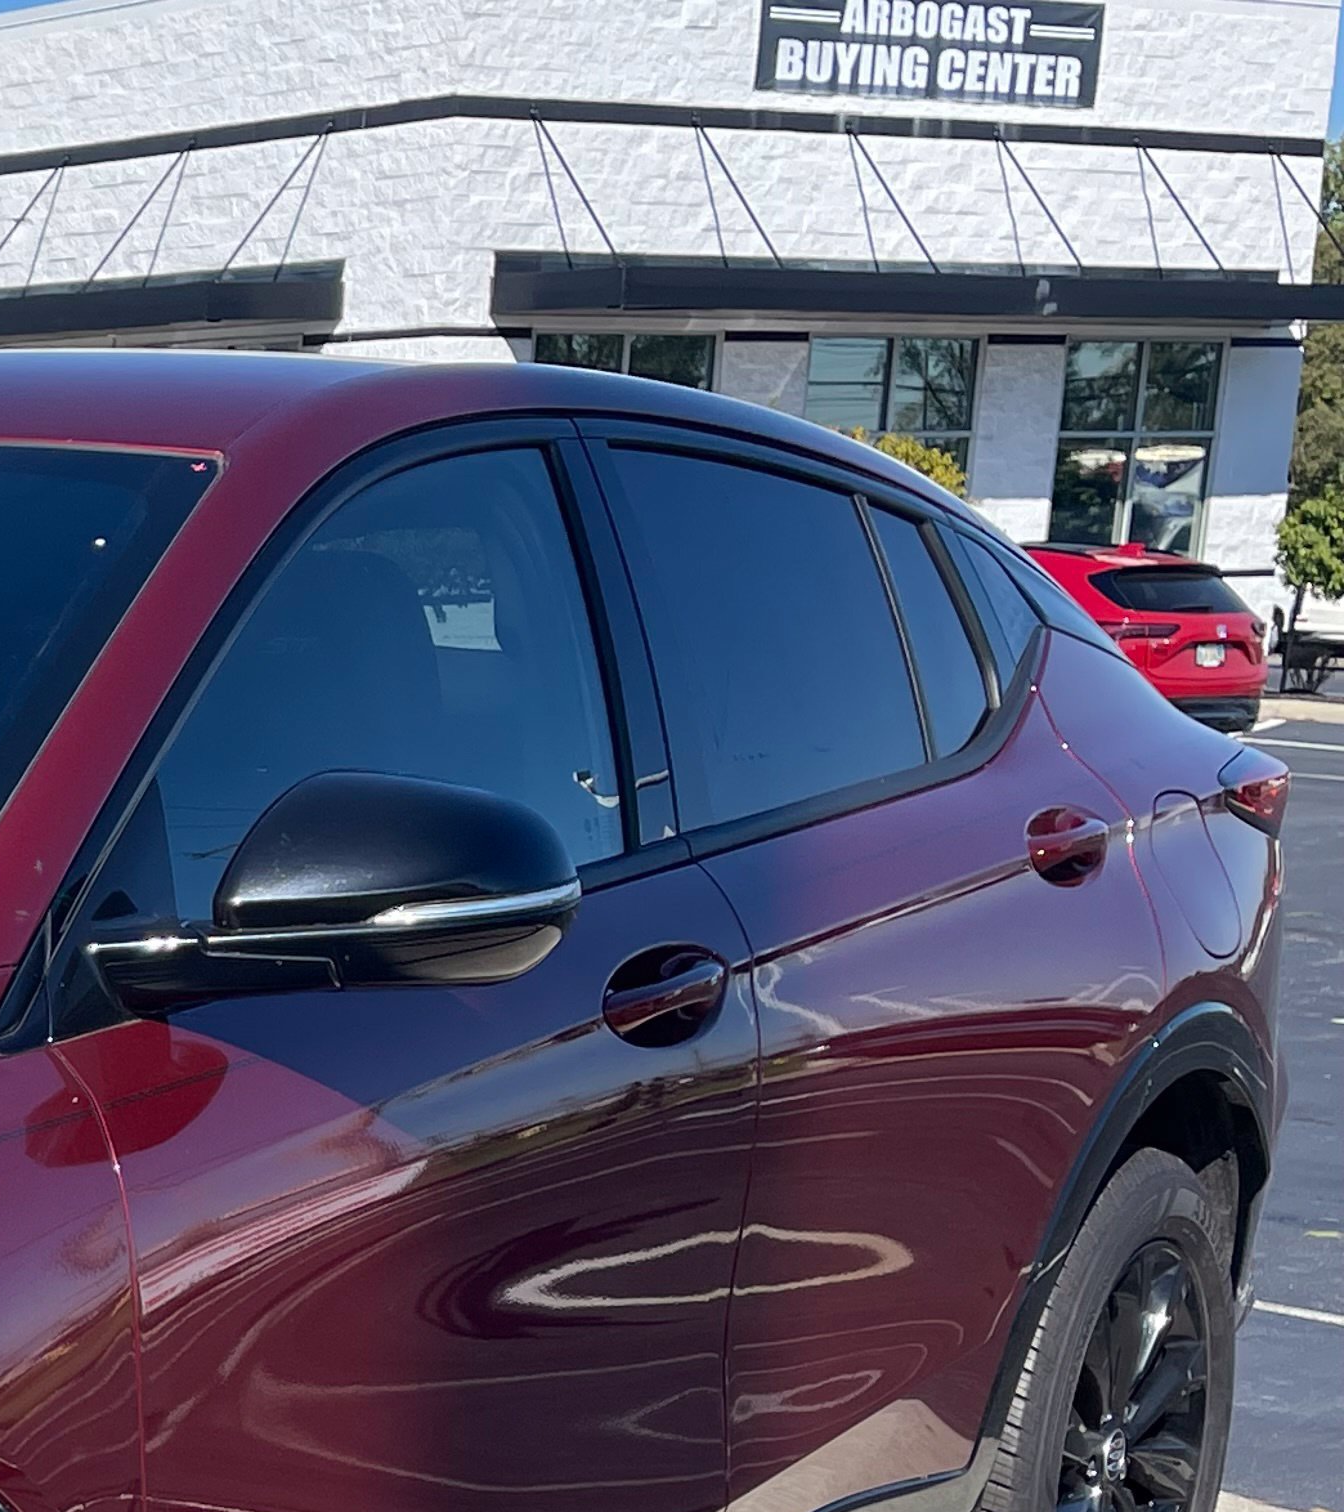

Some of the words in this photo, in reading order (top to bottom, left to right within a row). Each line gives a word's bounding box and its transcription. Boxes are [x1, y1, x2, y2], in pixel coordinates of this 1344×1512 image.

[840, 0, 1032, 45] ARBOGAST
[774, 38, 931, 90] BUYING
[936, 48, 1083, 98] CENTER
